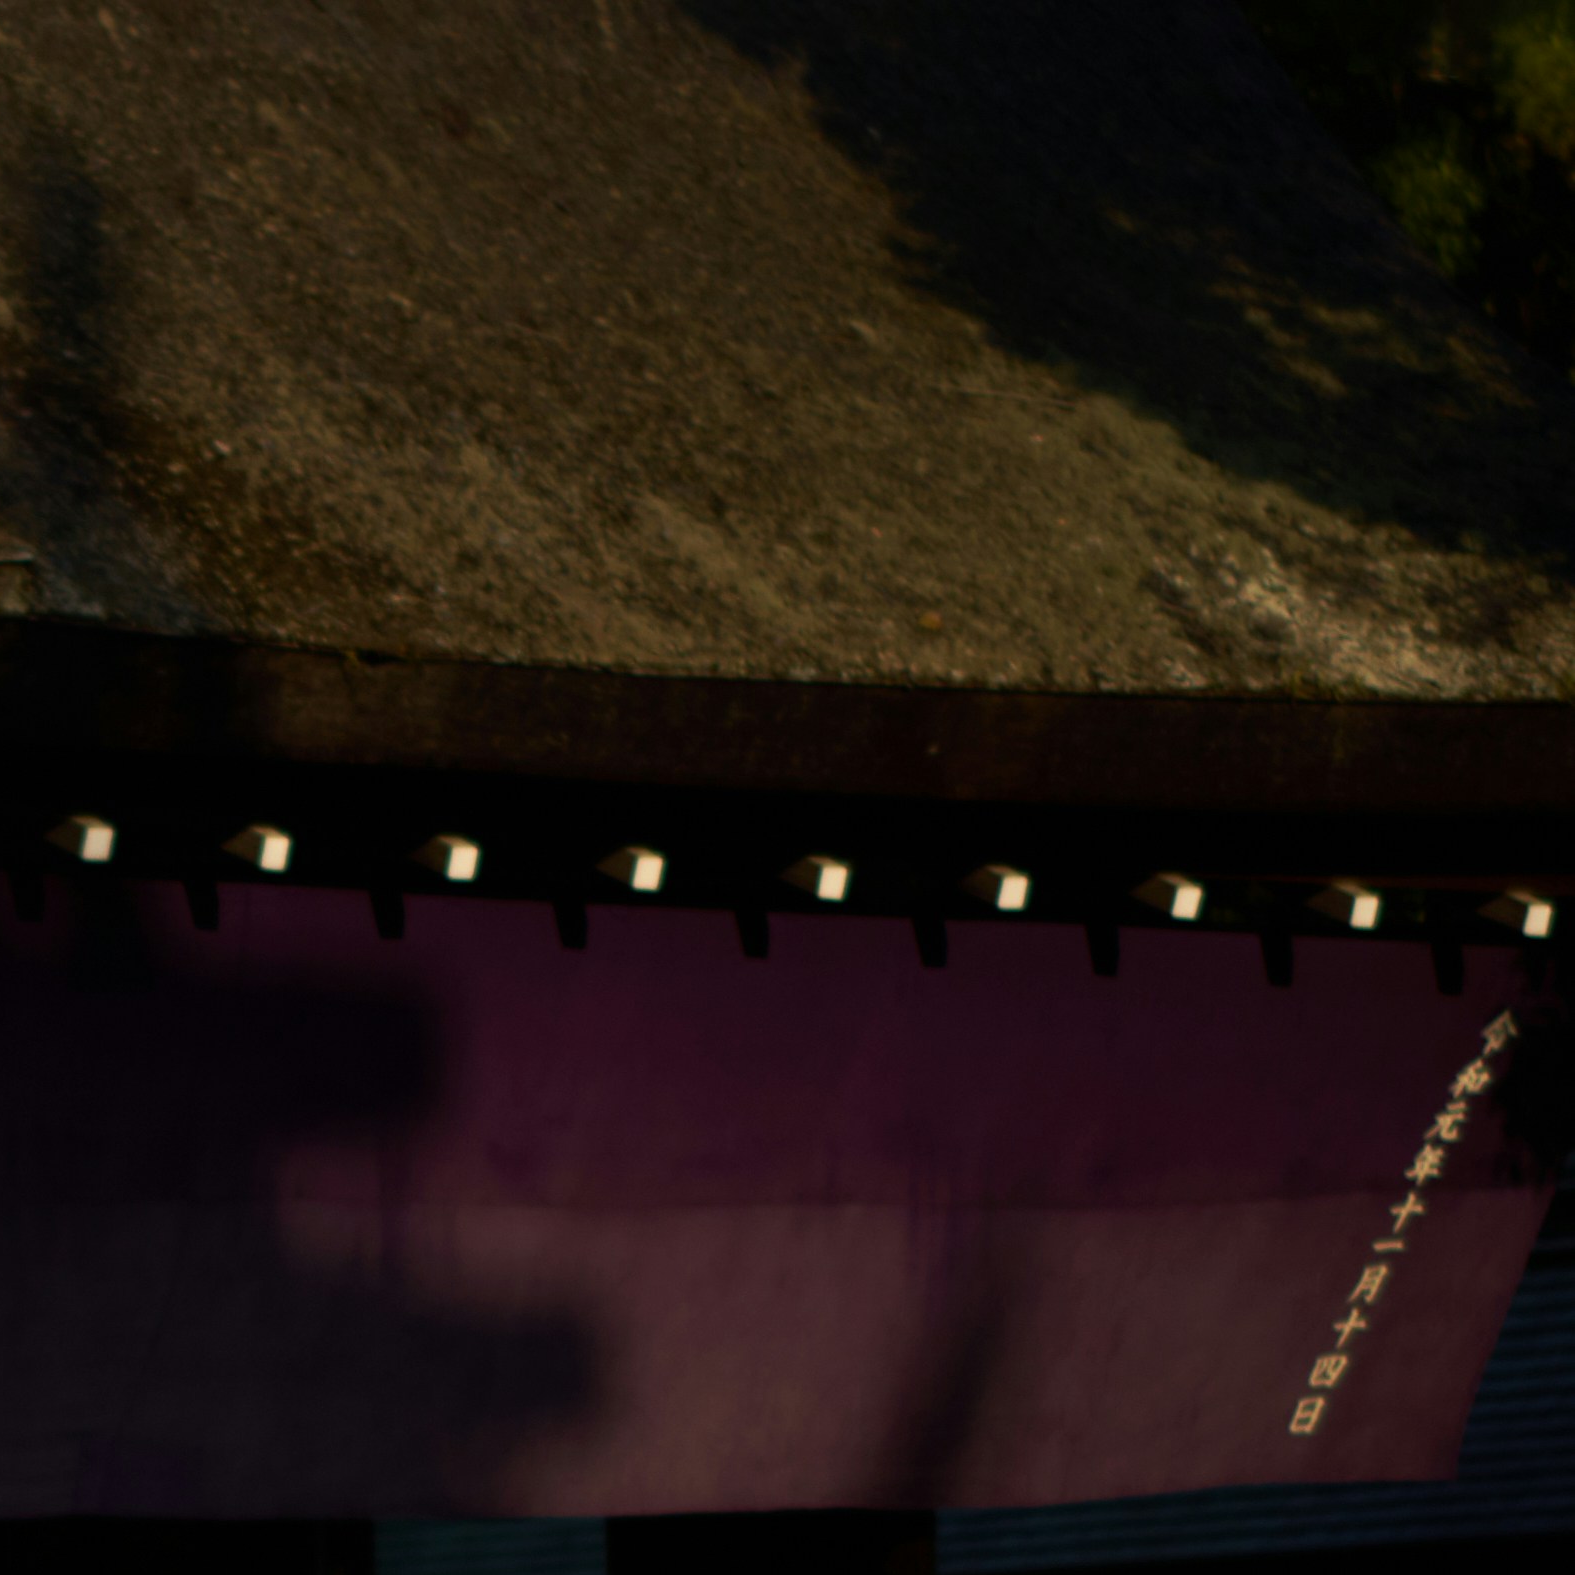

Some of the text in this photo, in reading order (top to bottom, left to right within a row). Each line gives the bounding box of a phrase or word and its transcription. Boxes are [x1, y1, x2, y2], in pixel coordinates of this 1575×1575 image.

[1289, 1010, 1519, 1434] 令和元年十一月十四日
